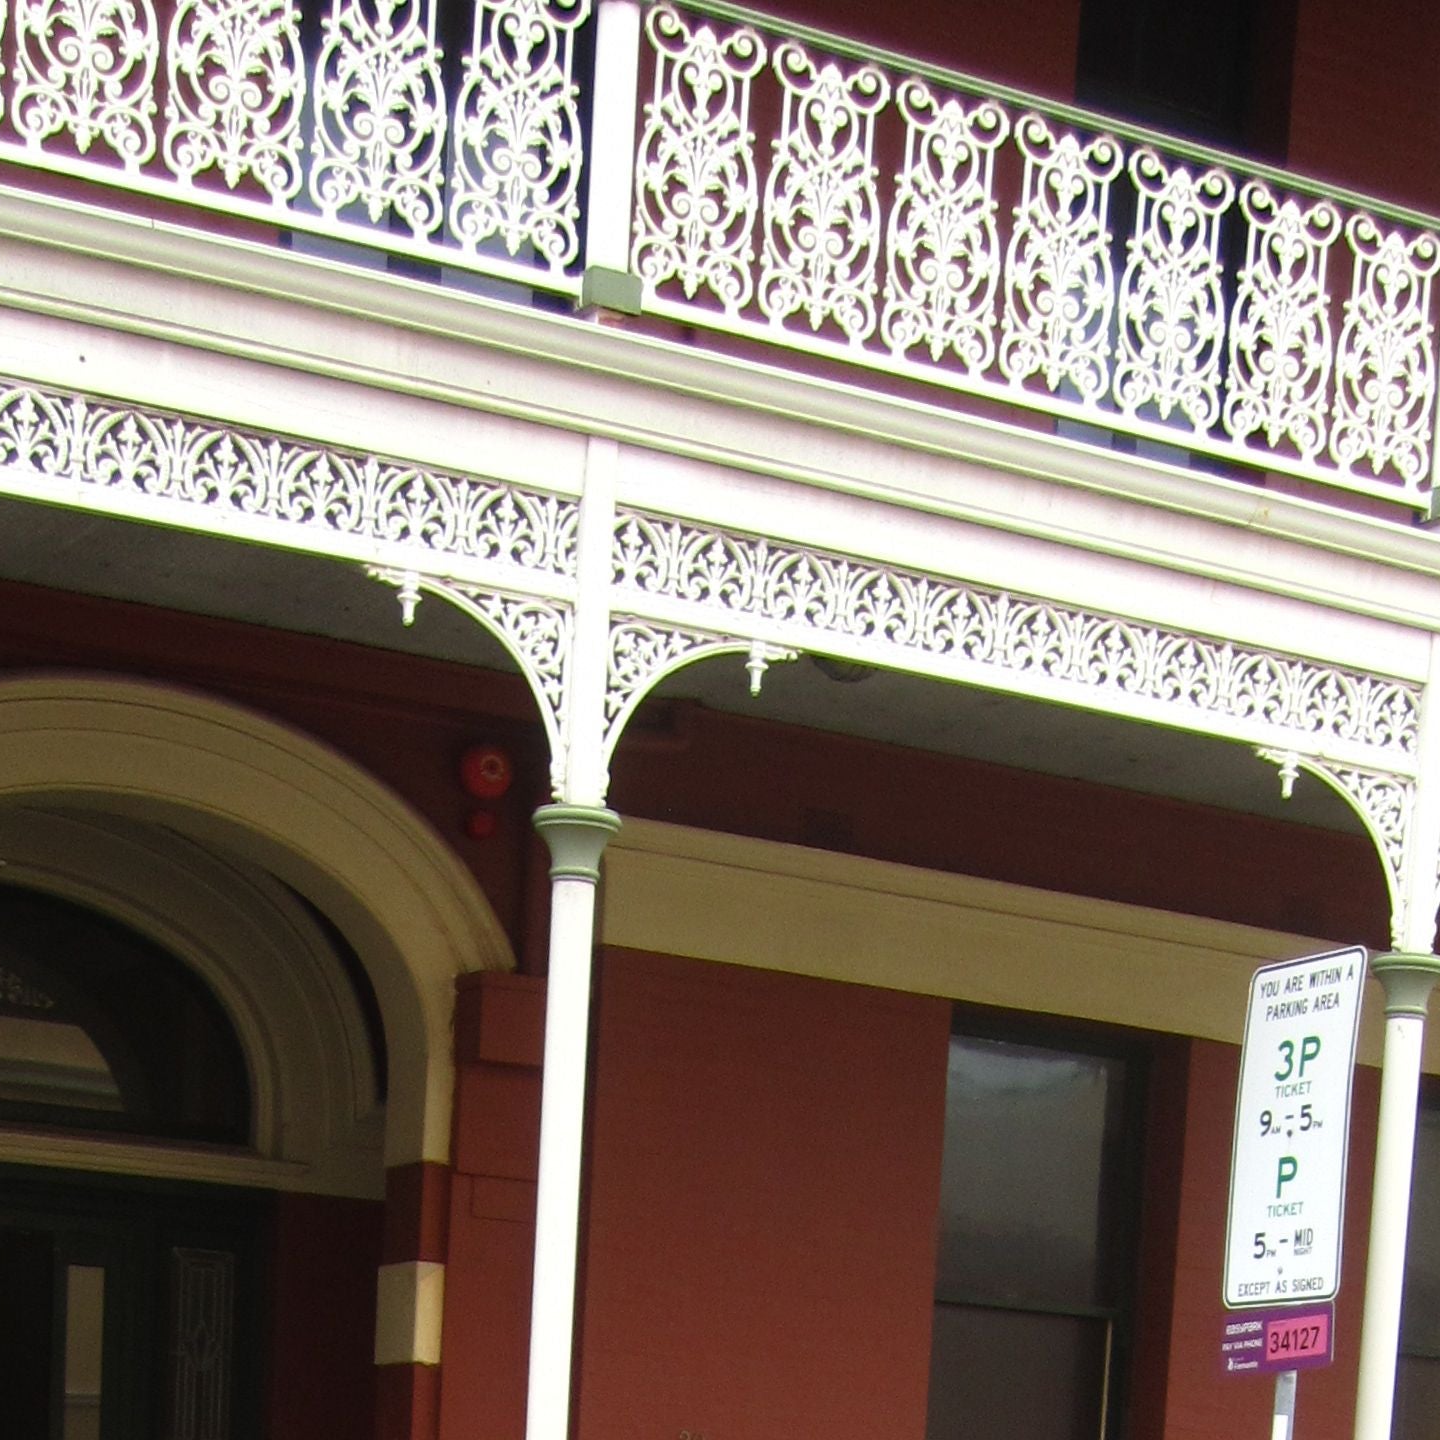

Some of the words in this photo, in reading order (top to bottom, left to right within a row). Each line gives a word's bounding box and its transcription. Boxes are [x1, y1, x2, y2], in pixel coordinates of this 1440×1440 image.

[1260, 980, 1280, 998] YOU
[1283, 974, 1304, 994] ARE
[1308, 966, 1343, 989] WITHIN
[1346, 963, 1354, 981] A
[1265, 998, 1309, 1022] PARKING
[1312, 992, 1340, 1013] AREA
[1274, 1036, 1321, 1081] 3P
[1274, 1081, 1312, 1099] TICKET
[1275, 1156, 1299, 1199] P
[1266, 1201, 1305, 1218] TICKET
[1294, 1227, 1314, 1246] MID
[1237, 1280, 1271, 1297] EXCEPT
[1274, 1279, 1288, 1294] AS
[1292, 1276, 1325, 1292] SIGNED
[1269, 1325, 1320, 1355] 34127
